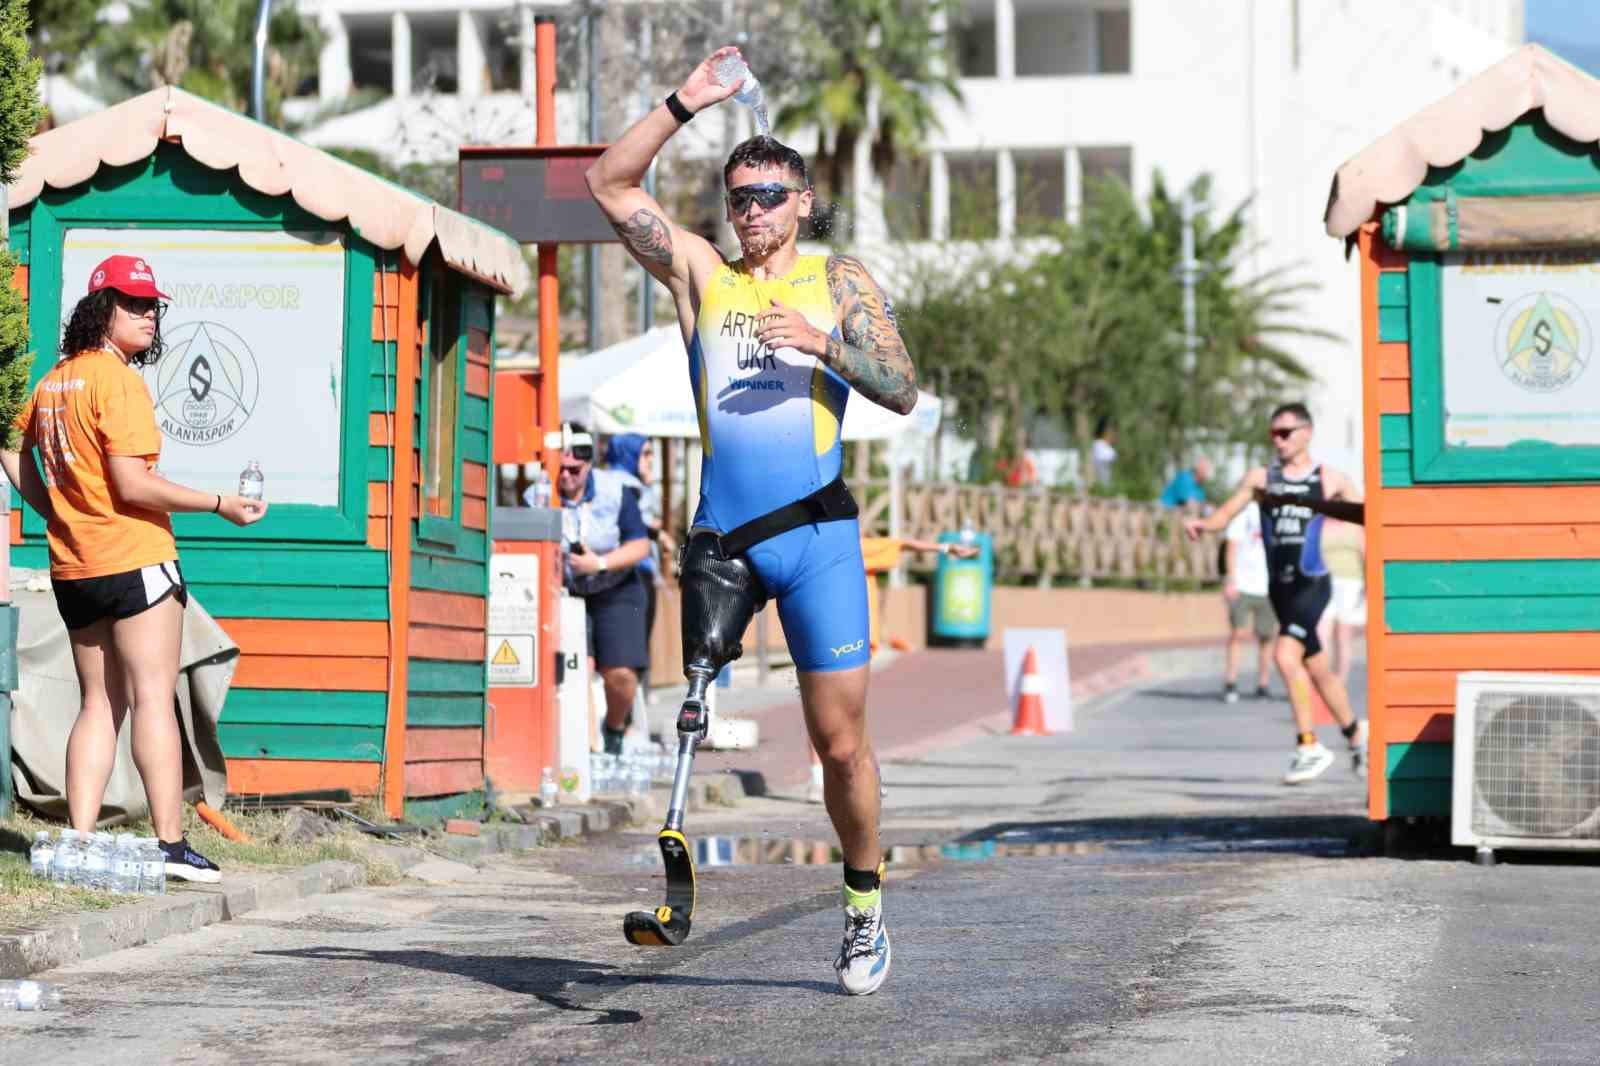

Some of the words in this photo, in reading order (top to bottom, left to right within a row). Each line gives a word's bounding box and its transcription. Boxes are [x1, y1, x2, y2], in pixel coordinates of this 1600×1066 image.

[737, 342, 777, 371] UKR
[728, 376, 786, 392] WINNER
[161, 418, 235, 441] ALANYASPOR
